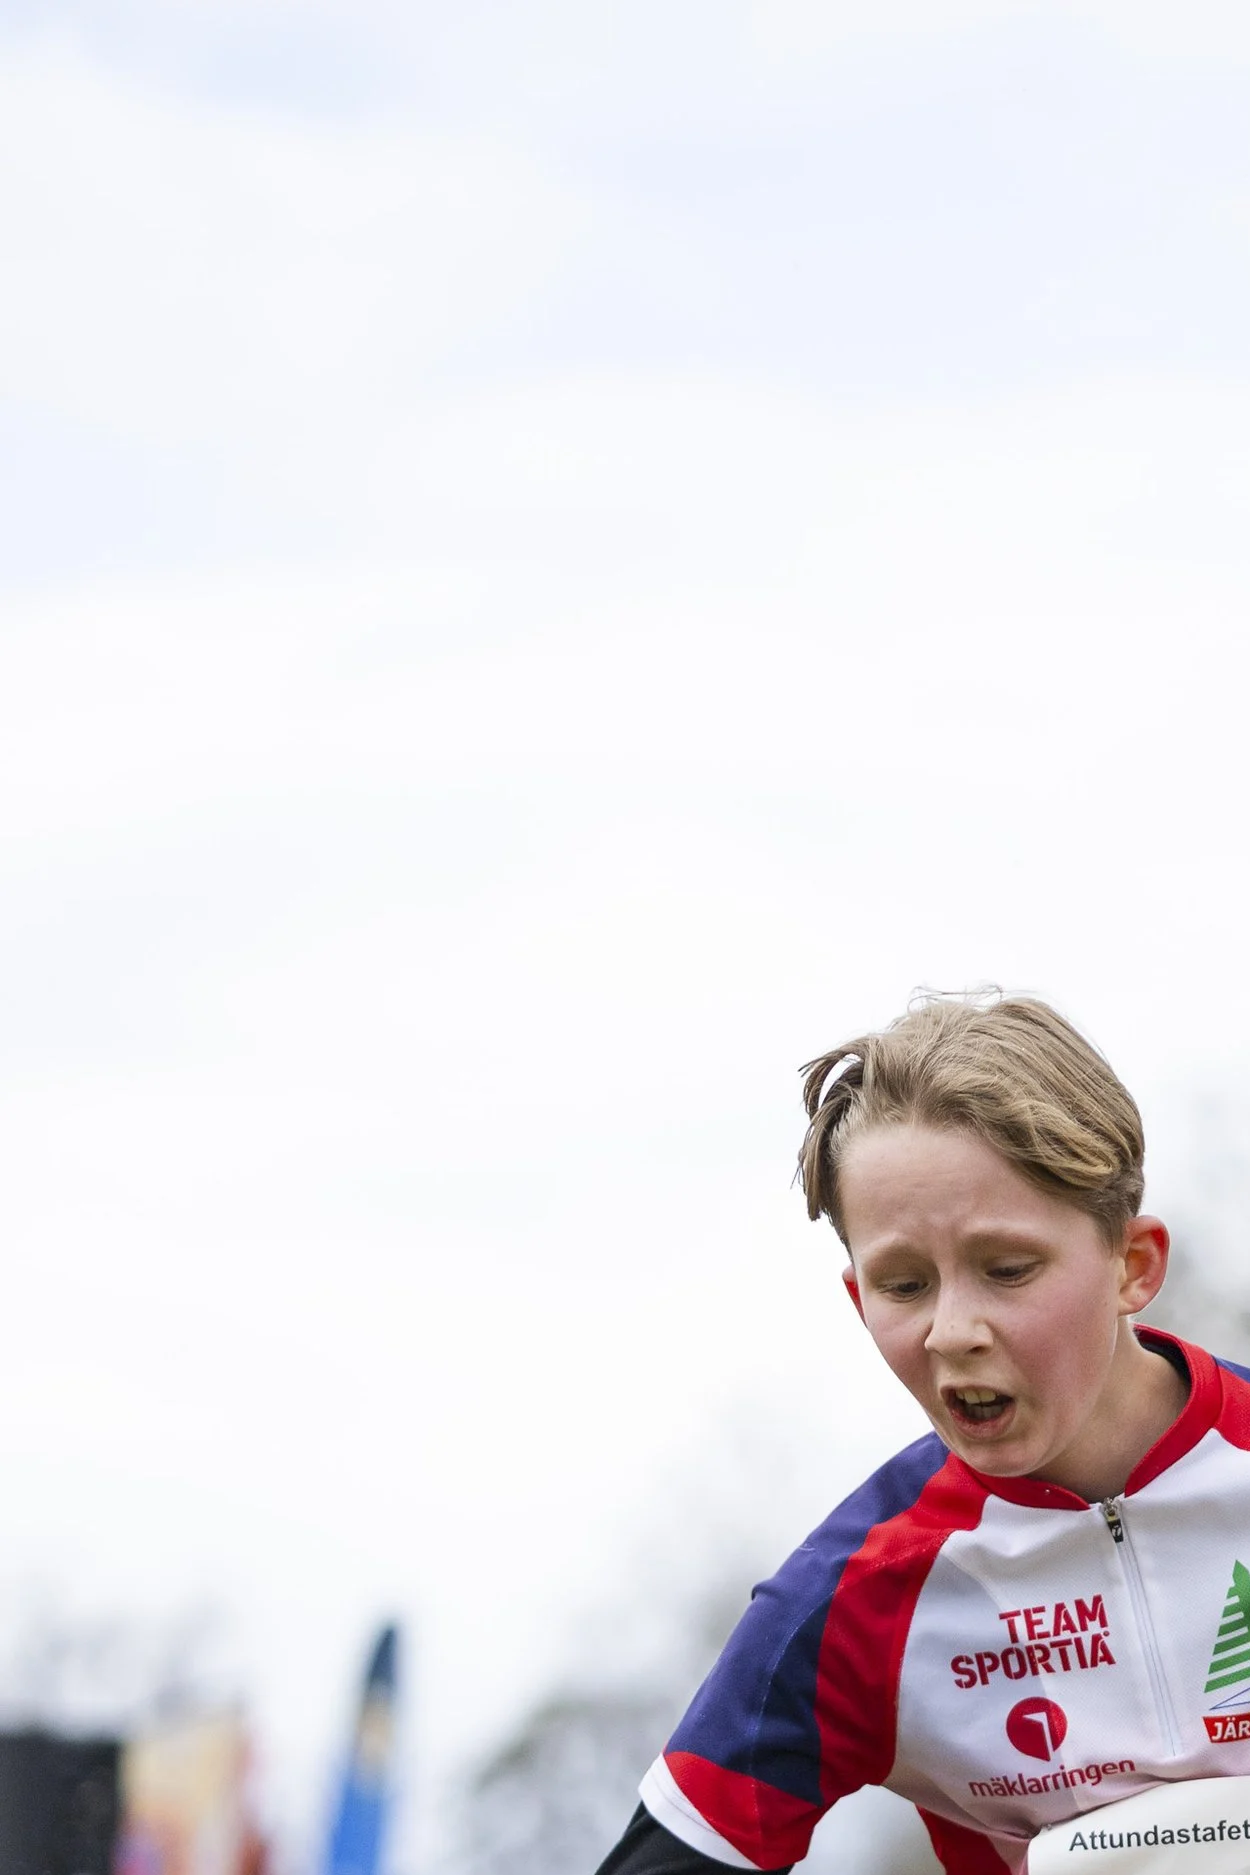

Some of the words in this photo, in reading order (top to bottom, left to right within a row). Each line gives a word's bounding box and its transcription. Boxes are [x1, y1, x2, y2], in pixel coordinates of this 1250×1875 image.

[999, 1594, 1109, 1644] TEAM
[950, 1632, 1117, 1690] SPORTIA
[968, 1759, 1137, 1798] mäklarringen
